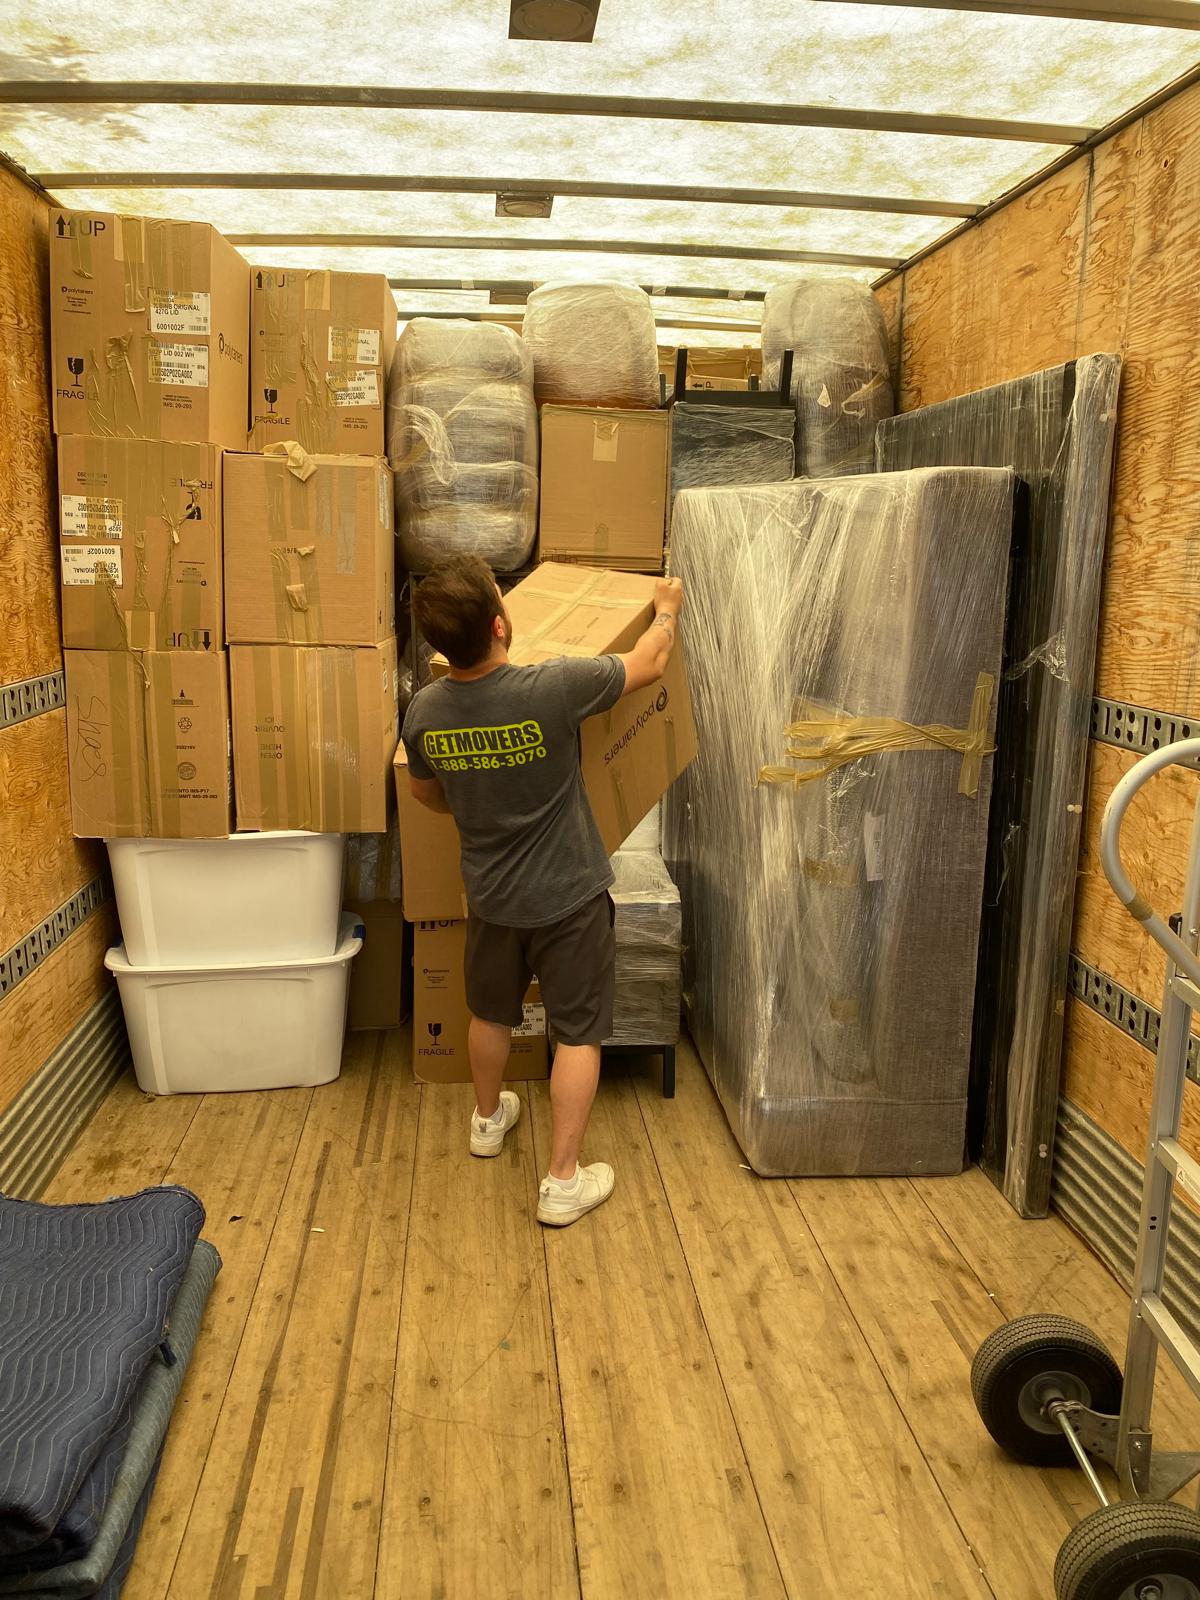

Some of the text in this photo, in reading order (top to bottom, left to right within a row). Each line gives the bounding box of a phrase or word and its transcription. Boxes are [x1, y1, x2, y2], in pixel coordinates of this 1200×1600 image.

[80, 219, 106, 237] UP
[275, 273, 297, 288] UP
[173, 303, 201, 312] ORIGINAL
[156, 322, 185, 332] 6001002F
[173, 350, 183, 358] 002
[184, 350, 195, 359] WH
[56, 389, 99, 401] FRAGILE
[87, 548, 116, 556] 6001002F
[72, 566, 99, 575] ORIGINAL
[164, 631, 190, 648] UP
[604, 701, 655, 766] polytainers
[425, 723, 540, 756] GETMOVERS
[260, 743, 282, 751] HERE
[260, 752, 283, 760] OPEN
[431, 746, 547, 771] 1-888-586-3070
[418, 1048, 456, 1056] FRAGILE
